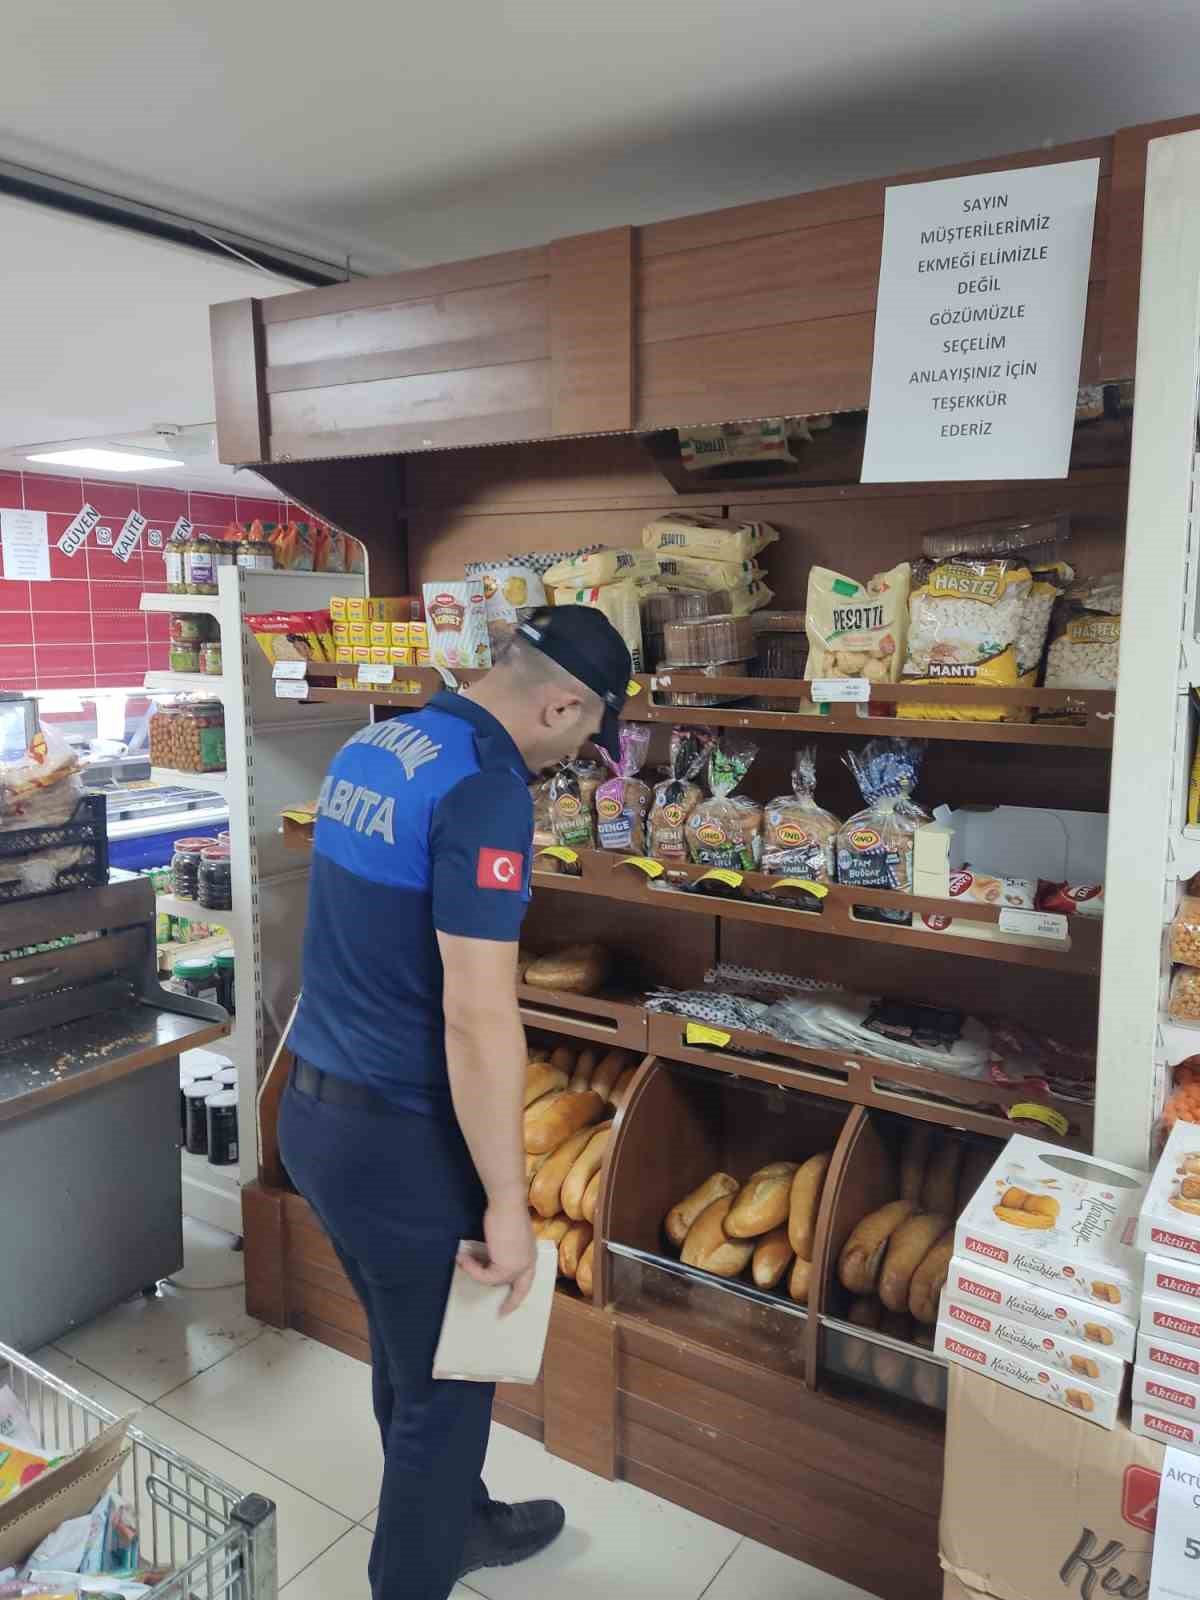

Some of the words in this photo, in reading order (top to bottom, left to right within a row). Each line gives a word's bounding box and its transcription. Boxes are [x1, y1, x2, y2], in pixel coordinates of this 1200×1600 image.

[962, 193, 1008, 213] SAYIN
[920, 213, 1050, 245] MÜŞTERİLERİMİZ
[917, 251, 975, 273] EKMEĞİ
[979, 246, 1048, 267] ELİMİZLE
[957, 277, 1001, 295] DEĞİL
[929, 304, 1025, 326] GÖZÜMÜZLE
[943, 334, 1006, 355] SEÇELİM
[909, 364, 1001, 385] ANLAYIŞINIZ
[1005, 359, 1037, 379] İÇİN
[932, 392, 1007, 411] TEŞEKKÜR
[940, 420, 993, 437] EDERİZ
[62, 507, 99, 554] GÜVEN
[116, 513, 144, 559] KALİTE
[317, 775, 395, 845] ABITA
[1060, 1527, 1150, 1600] Ku
